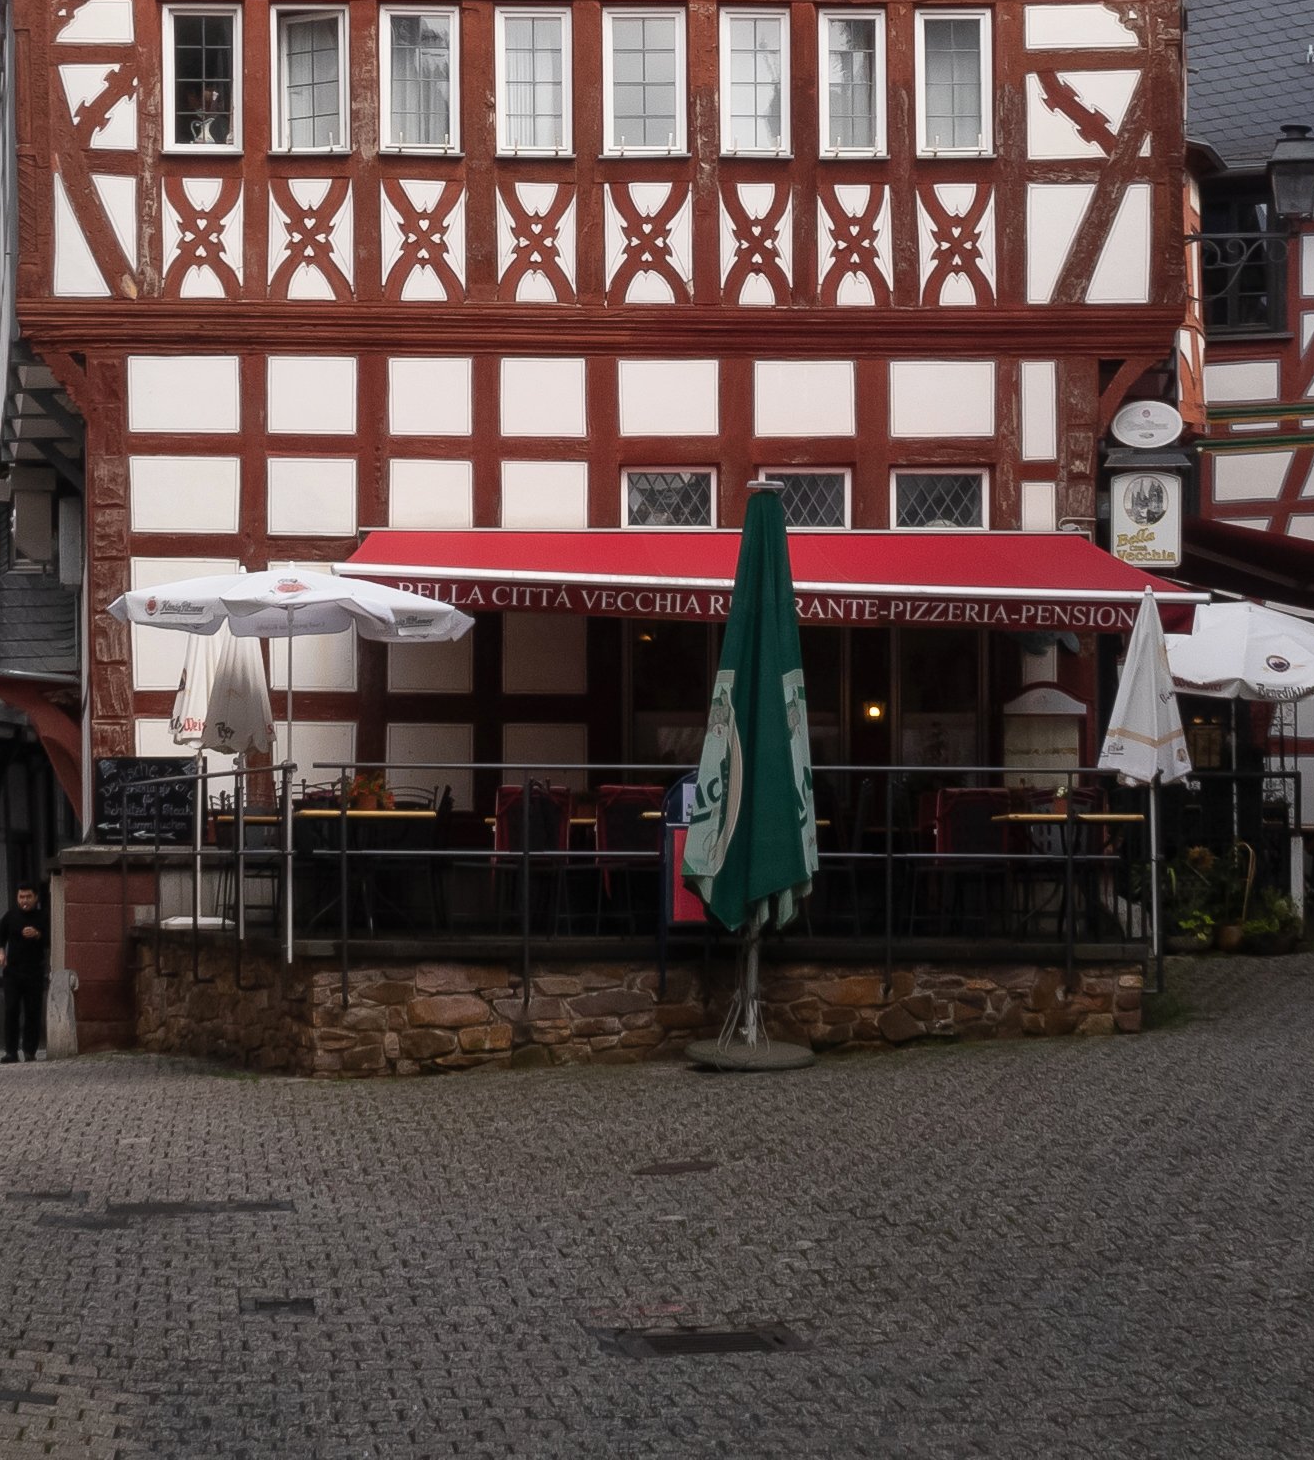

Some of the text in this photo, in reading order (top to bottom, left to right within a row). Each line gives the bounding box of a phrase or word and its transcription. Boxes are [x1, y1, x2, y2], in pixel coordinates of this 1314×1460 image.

[1117, 528, 1156, 547] Bella
[1117, 549, 1176, 562] Vecchia
[398, 582, 486, 605] BELLA
[580, 590, 701, 614] VECCHIA
